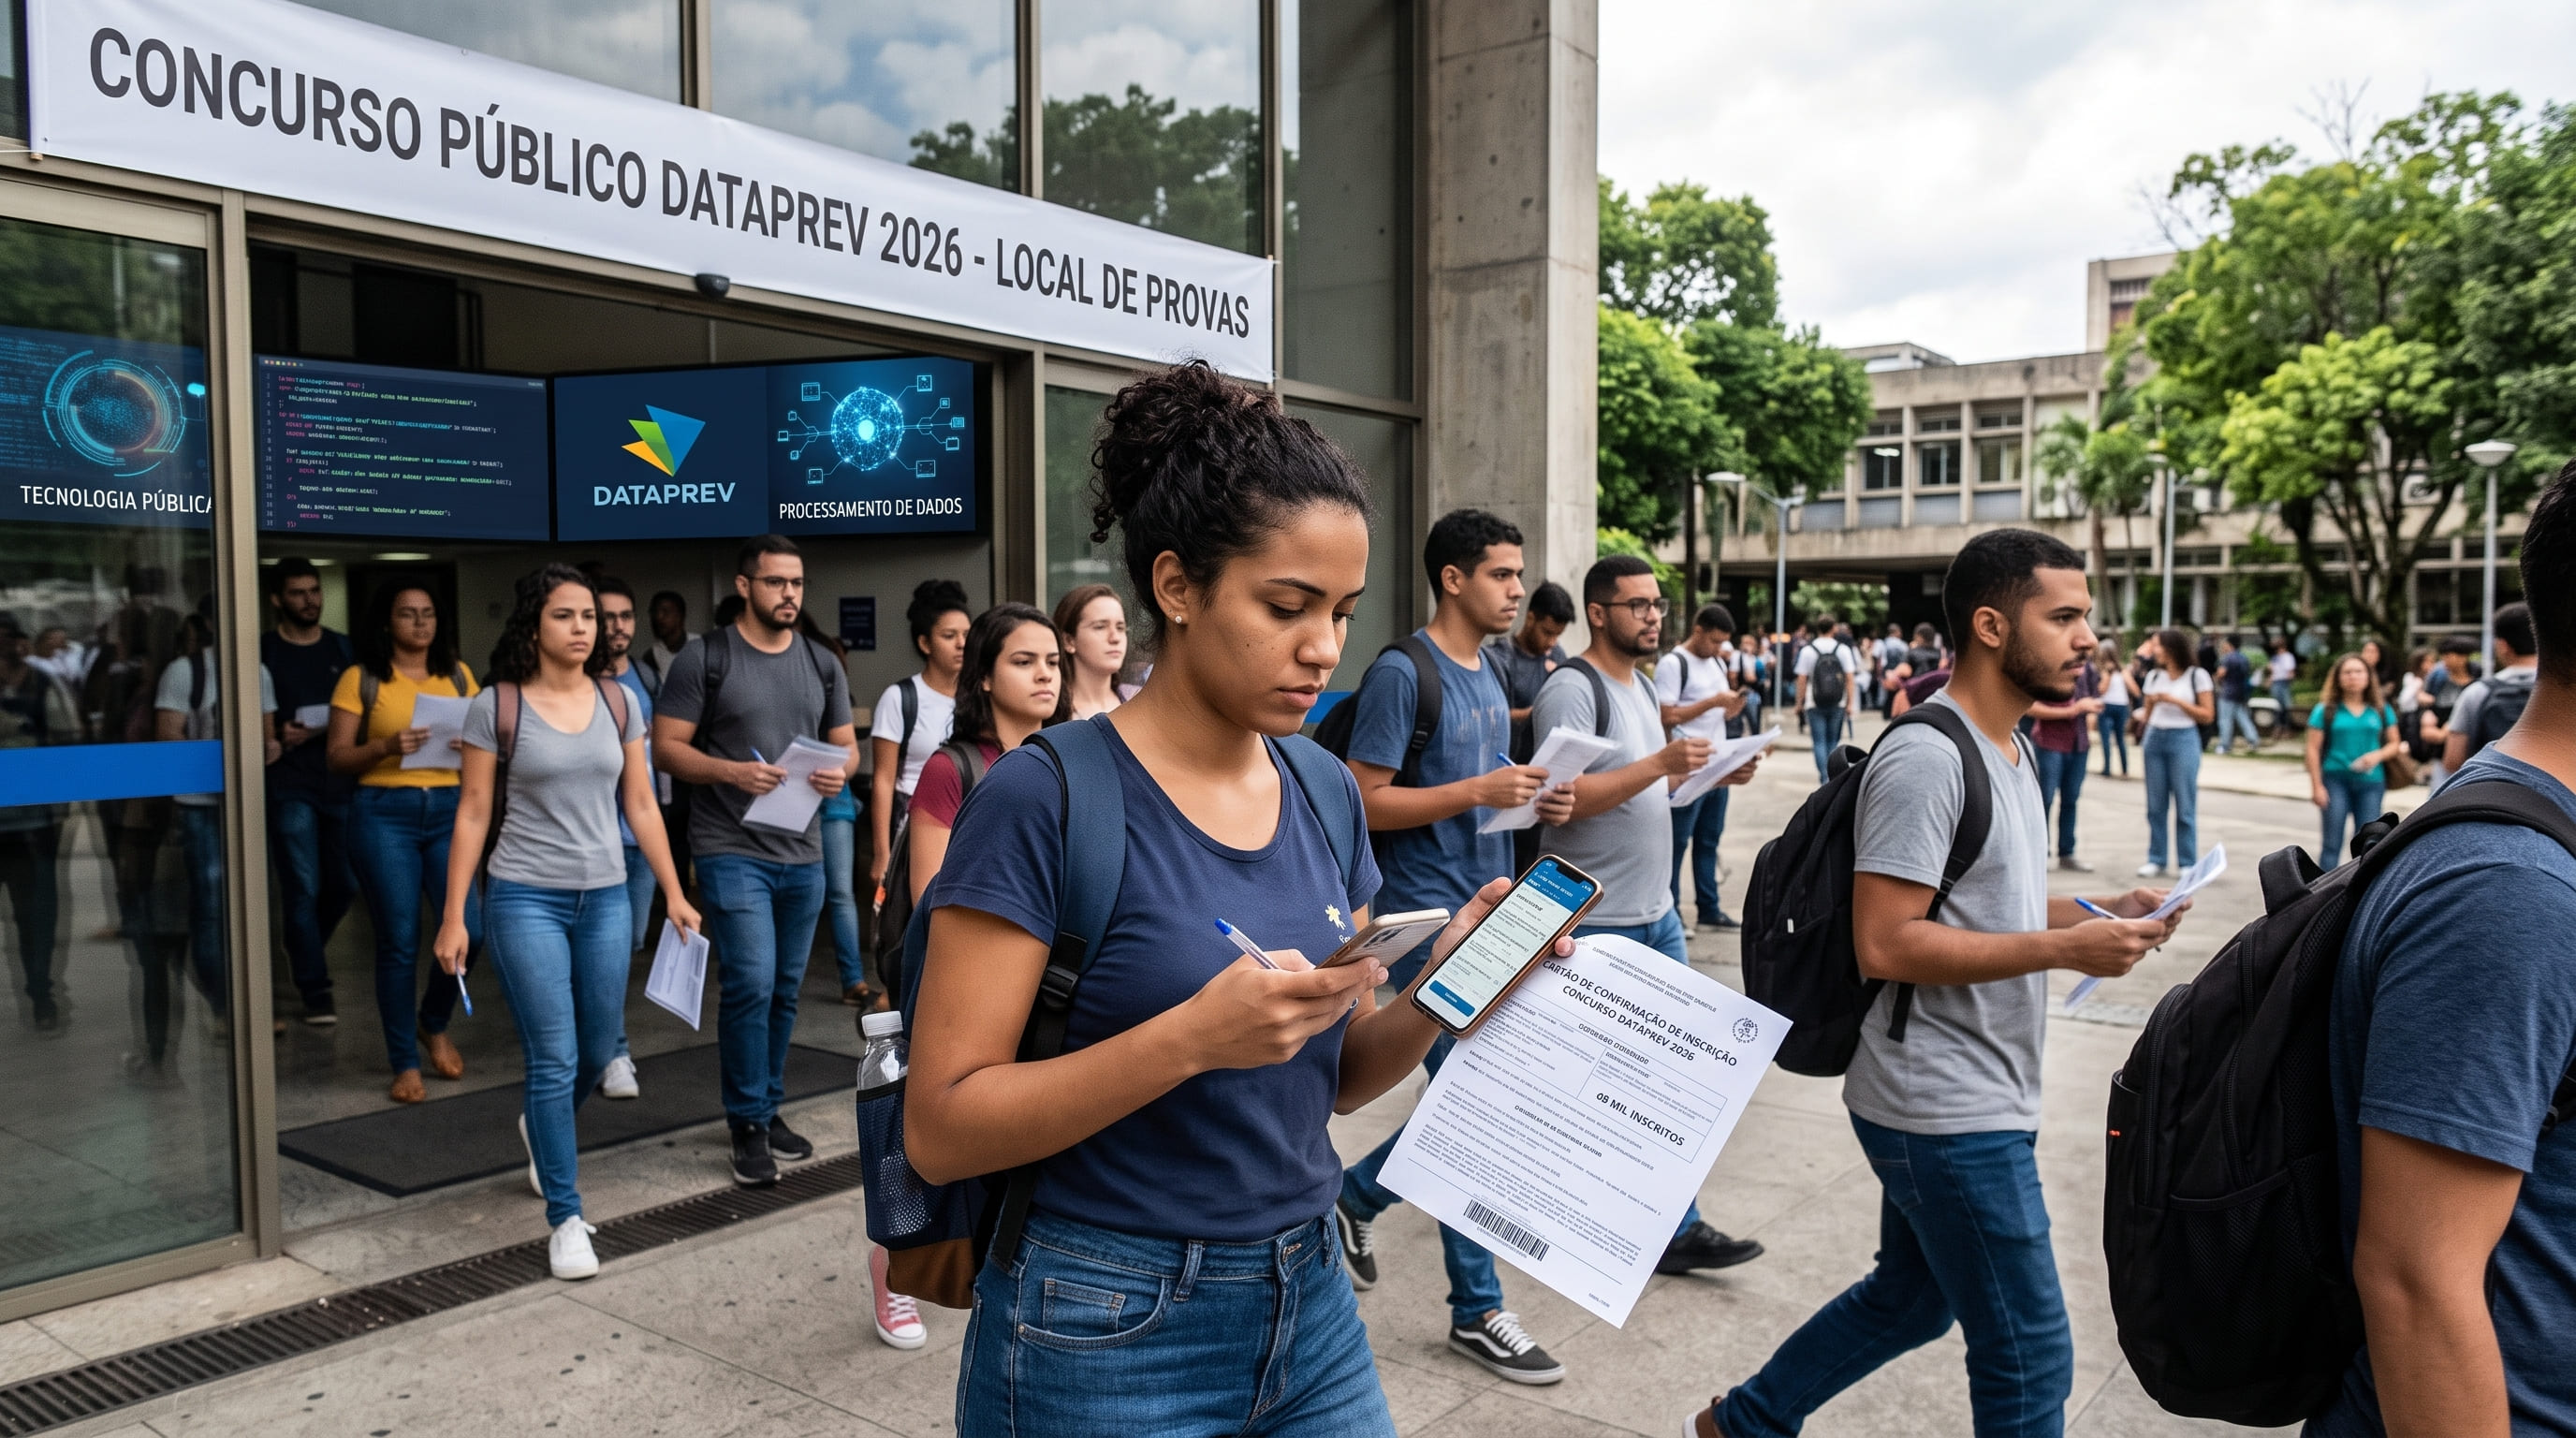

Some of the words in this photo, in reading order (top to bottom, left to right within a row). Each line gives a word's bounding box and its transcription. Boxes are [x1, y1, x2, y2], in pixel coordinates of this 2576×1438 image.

[90, 27, 421, 161] CONCURSO
[440, 103, 648, 209] PÚBLICO
[662, 159, 870, 257] DATAPREV
[880, 212, 963, 277] 2026
[973, 255, 986, 266] -
[997, 238, 1093, 306] LOCAL
[1103, 262, 1138, 315] DE
[1146, 273, 1250, 339] PROVAS
[20, 485, 138, 510] TECNOLOGIA
[593, 482, 736, 506] DATAPREV
[780, 499, 892, 520] PROCESSAMENTO
[895, 498, 914, 516] DE
[916, 497, 963, 515] DADOS
[1562, 985, 1617, 1019] CONCURSO
[1617, 1014, 1671, 1047] DATAPREV
[1579, 977, 1594, 990] DE
[1593, 986, 1667, 1029] CONFIRMAÇÃO
[1667, 1023, 1683, 1037] DE
[1682, 1032, 1737, 1066] INSCRIÇÃO
[1609, 1099, 1628, 1116] MIL
[1630, 1109, 1686, 1147] INSCRITOS
